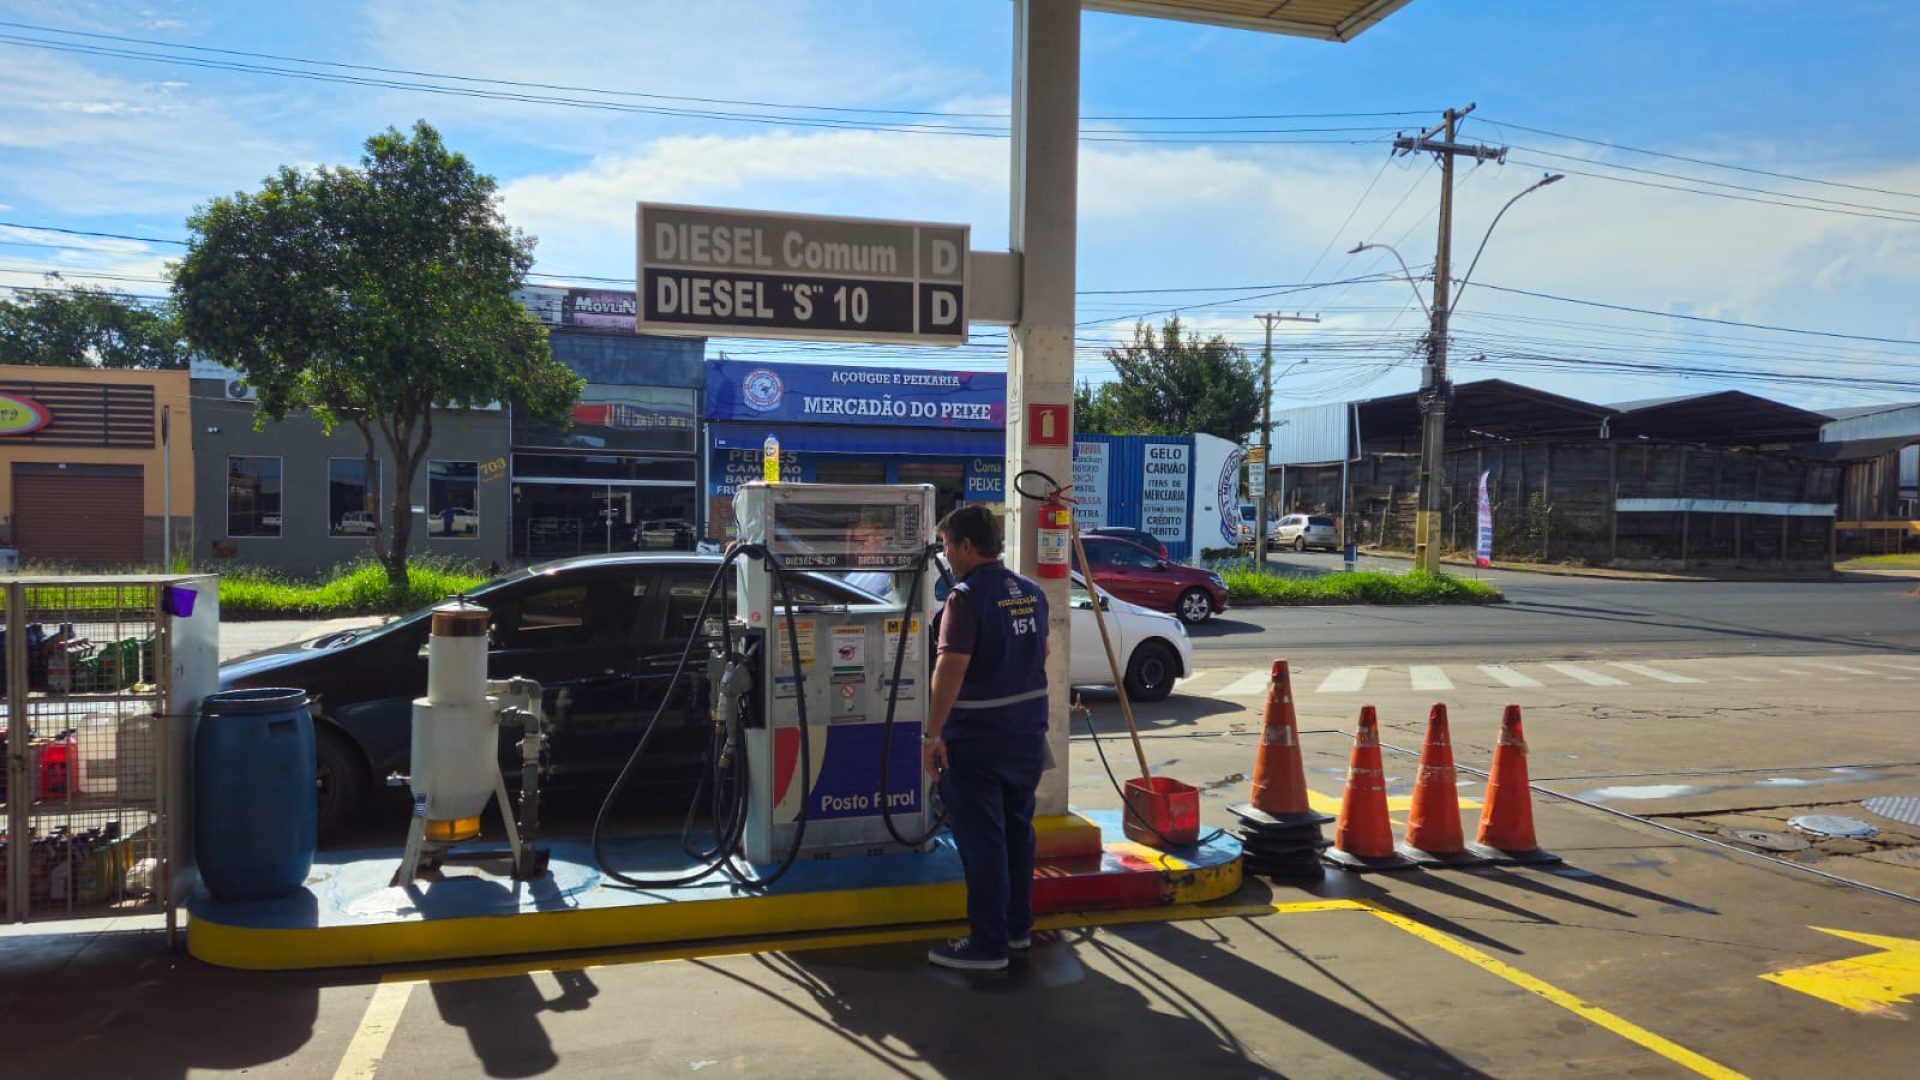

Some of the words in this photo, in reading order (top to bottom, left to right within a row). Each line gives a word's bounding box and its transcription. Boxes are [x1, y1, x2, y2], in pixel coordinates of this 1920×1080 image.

[654, 221, 773, 266] DIESEL
[782, 229, 897, 273] Comum
[932, 239, 958, 275] D
[656, 275, 774, 319] DIESEL
[833, 286, 869, 324] 10
[932, 290, 957, 325] D
[831, 372, 890, 385] AÇOUGUE
[893, 374, 901, 385] E
[903, 374, 960, 387] PEIXARIA
[803, 394, 908, 419] MERCADÃO
[910, 402, 938, 419] DO
[941, 403, 991, 421] PEIXE
[729, 451, 798, 464] PEIES
[1150, 448, 1182, 459] GELO
[726, 463, 802, 475] CAMÃO
[1146, 461, 1187, 474] CARVÃO
[969, 476, 1002, 492] PEIXE
[858, 556, 885, 565] DIESEL
[1012, 616, 1038, 636] 151
[821, 794, 869, 813] Posto
